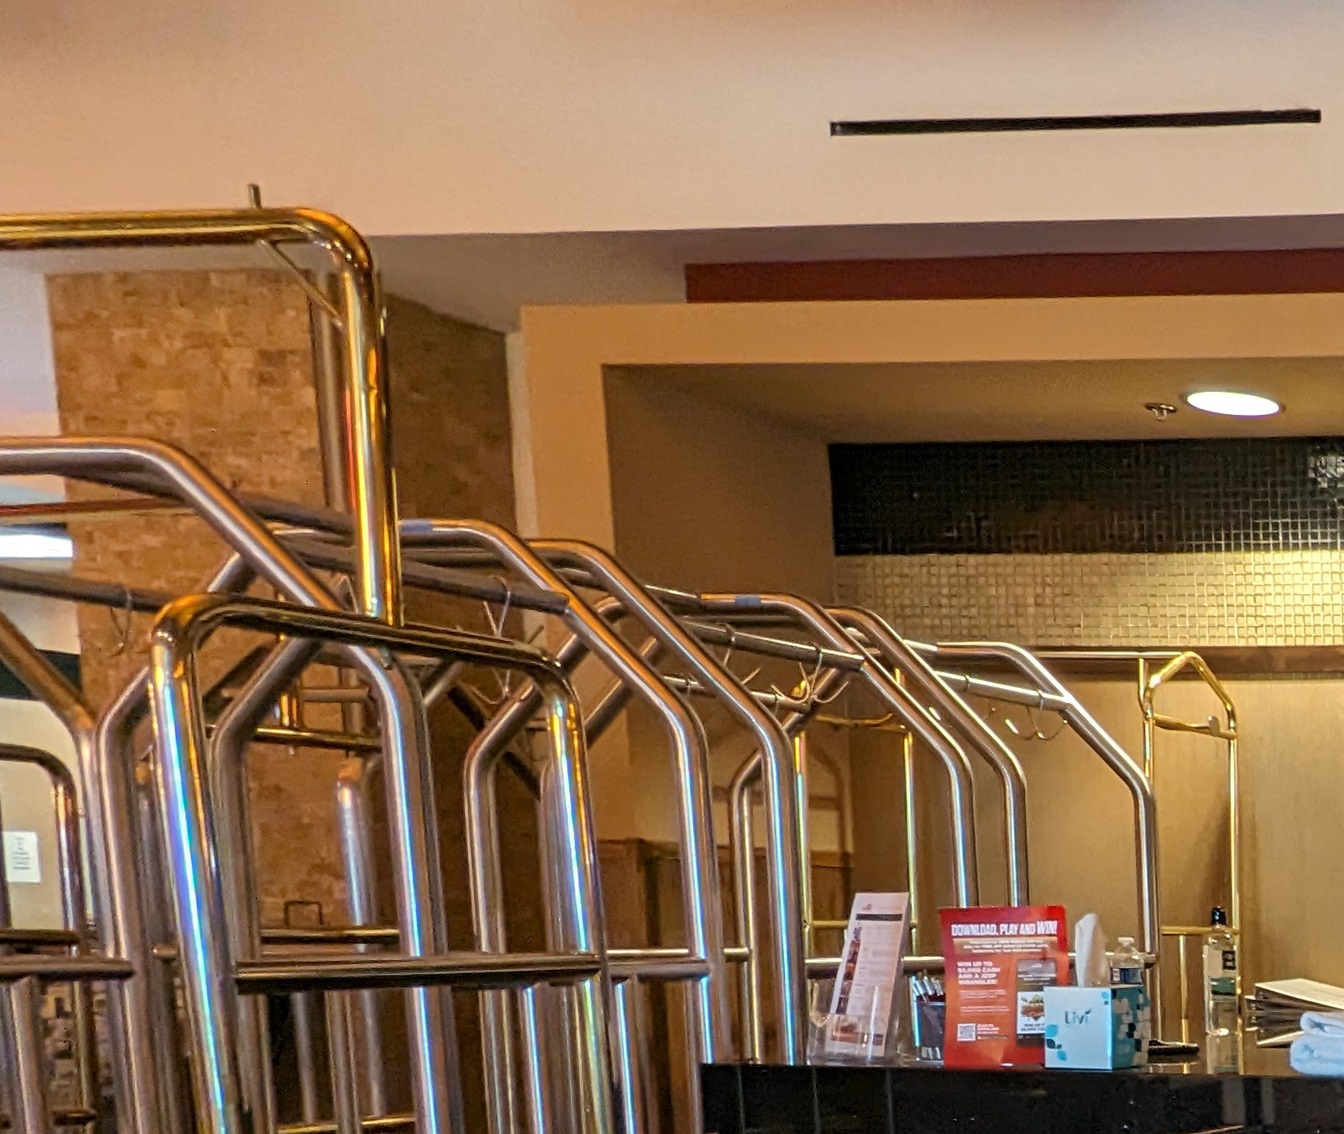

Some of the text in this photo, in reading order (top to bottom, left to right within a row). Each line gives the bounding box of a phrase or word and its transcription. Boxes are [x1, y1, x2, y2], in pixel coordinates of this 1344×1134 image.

[1000, 922, 1020, 935] PLAY
[1020, 922, 1036, 935] AND
[1036, 920, 1058, 934] WIN!
[1065, 1009, 1092, 1025] Livi
